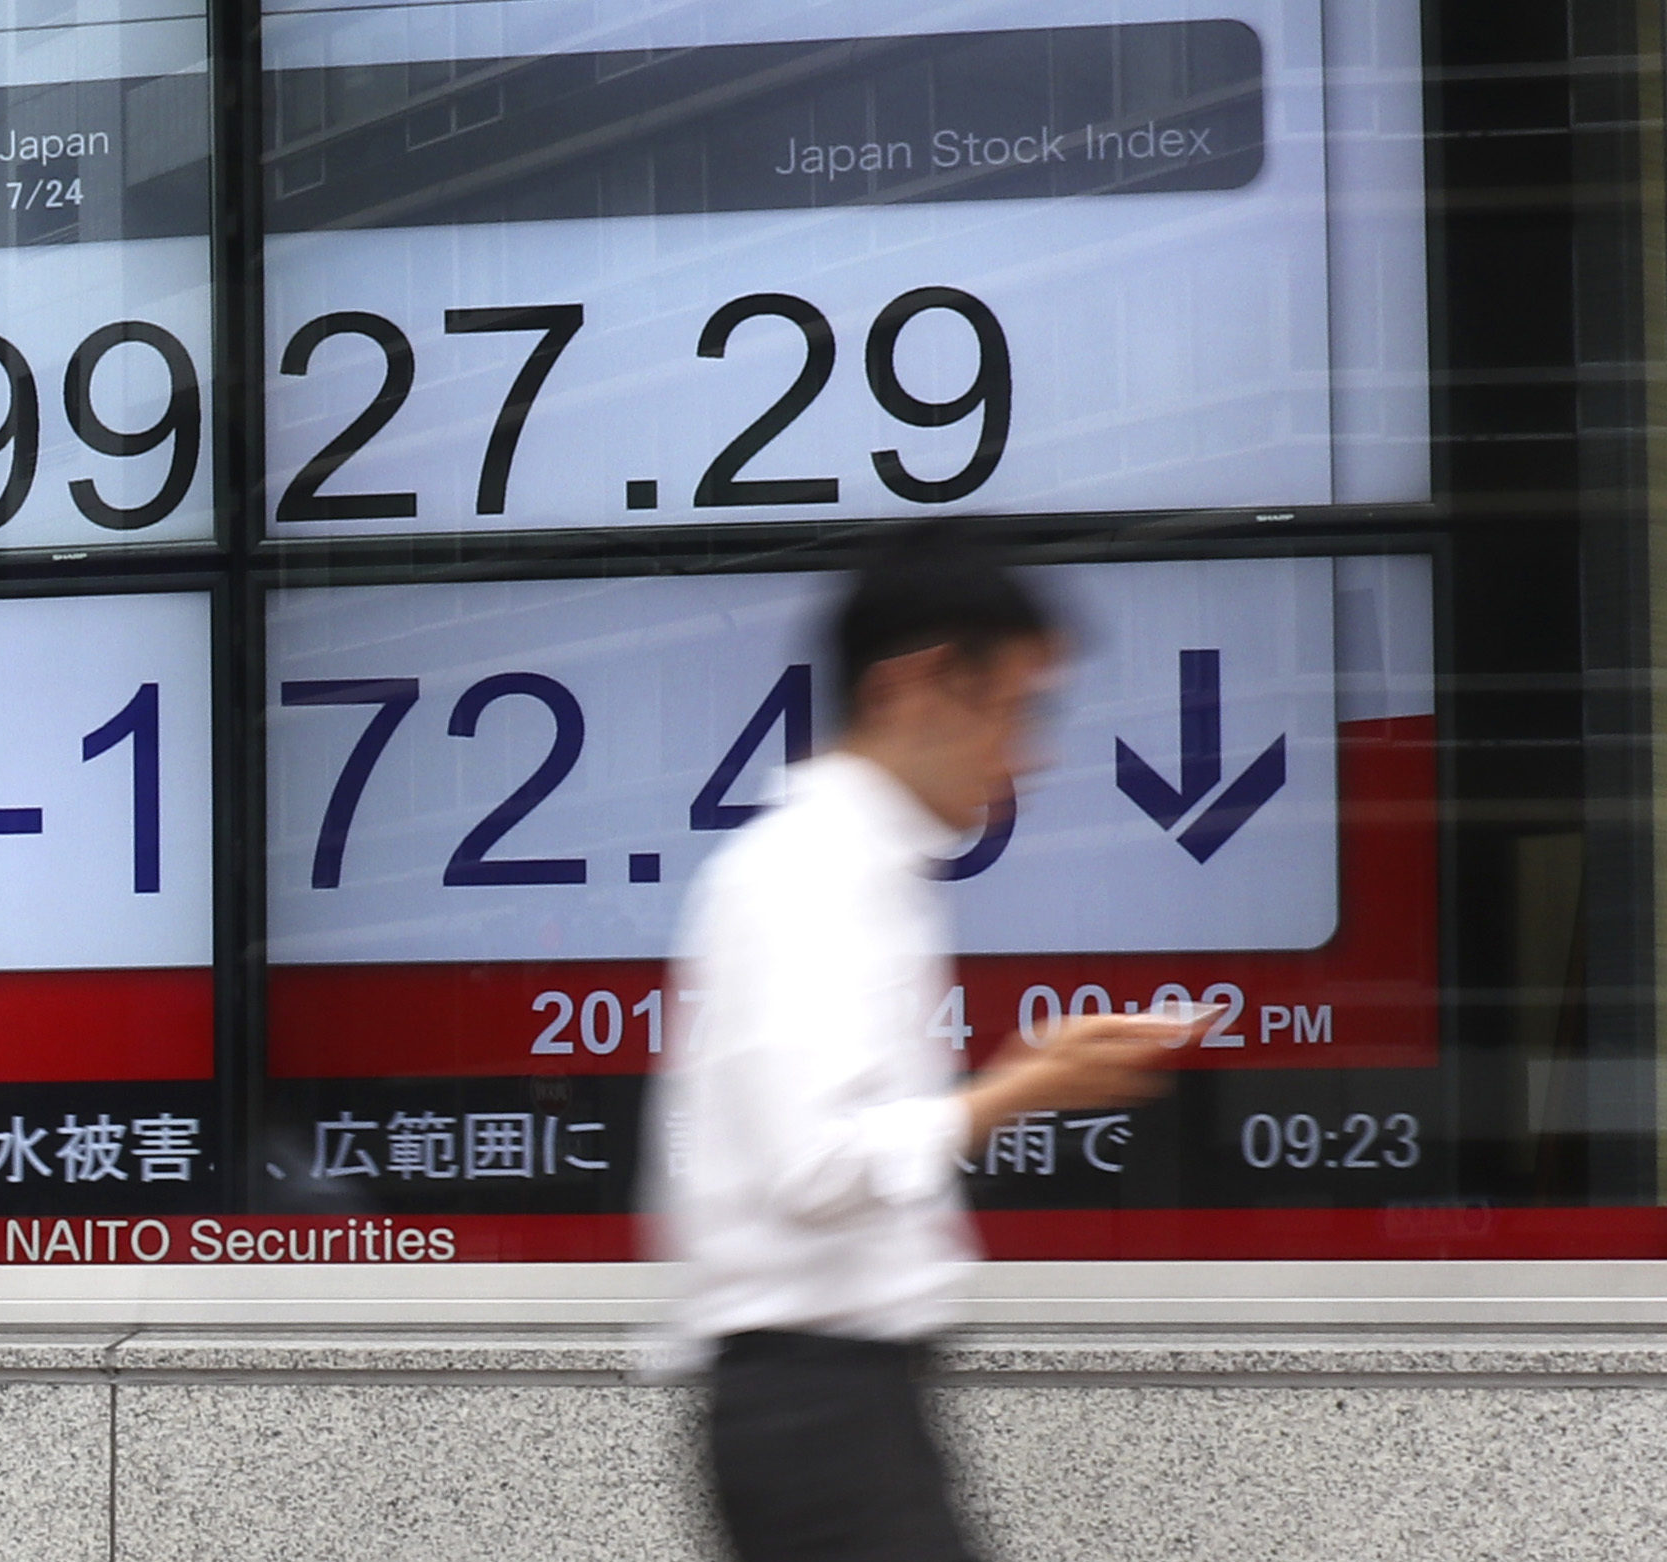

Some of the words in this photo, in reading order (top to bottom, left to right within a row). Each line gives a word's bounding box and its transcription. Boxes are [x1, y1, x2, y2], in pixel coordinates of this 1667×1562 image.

[775, 138, 912, 181] Japan
[932, 125, 1065, 168] Stock
[1087, 121, 1211, 161] Index
[1260, 1004, 1334, 1045] PM
[1241, 1112, 1422, 1170] 09:23
[6, 1219, 169, 1262] NAITO
[190, 1218, 455, 1262] Securities
